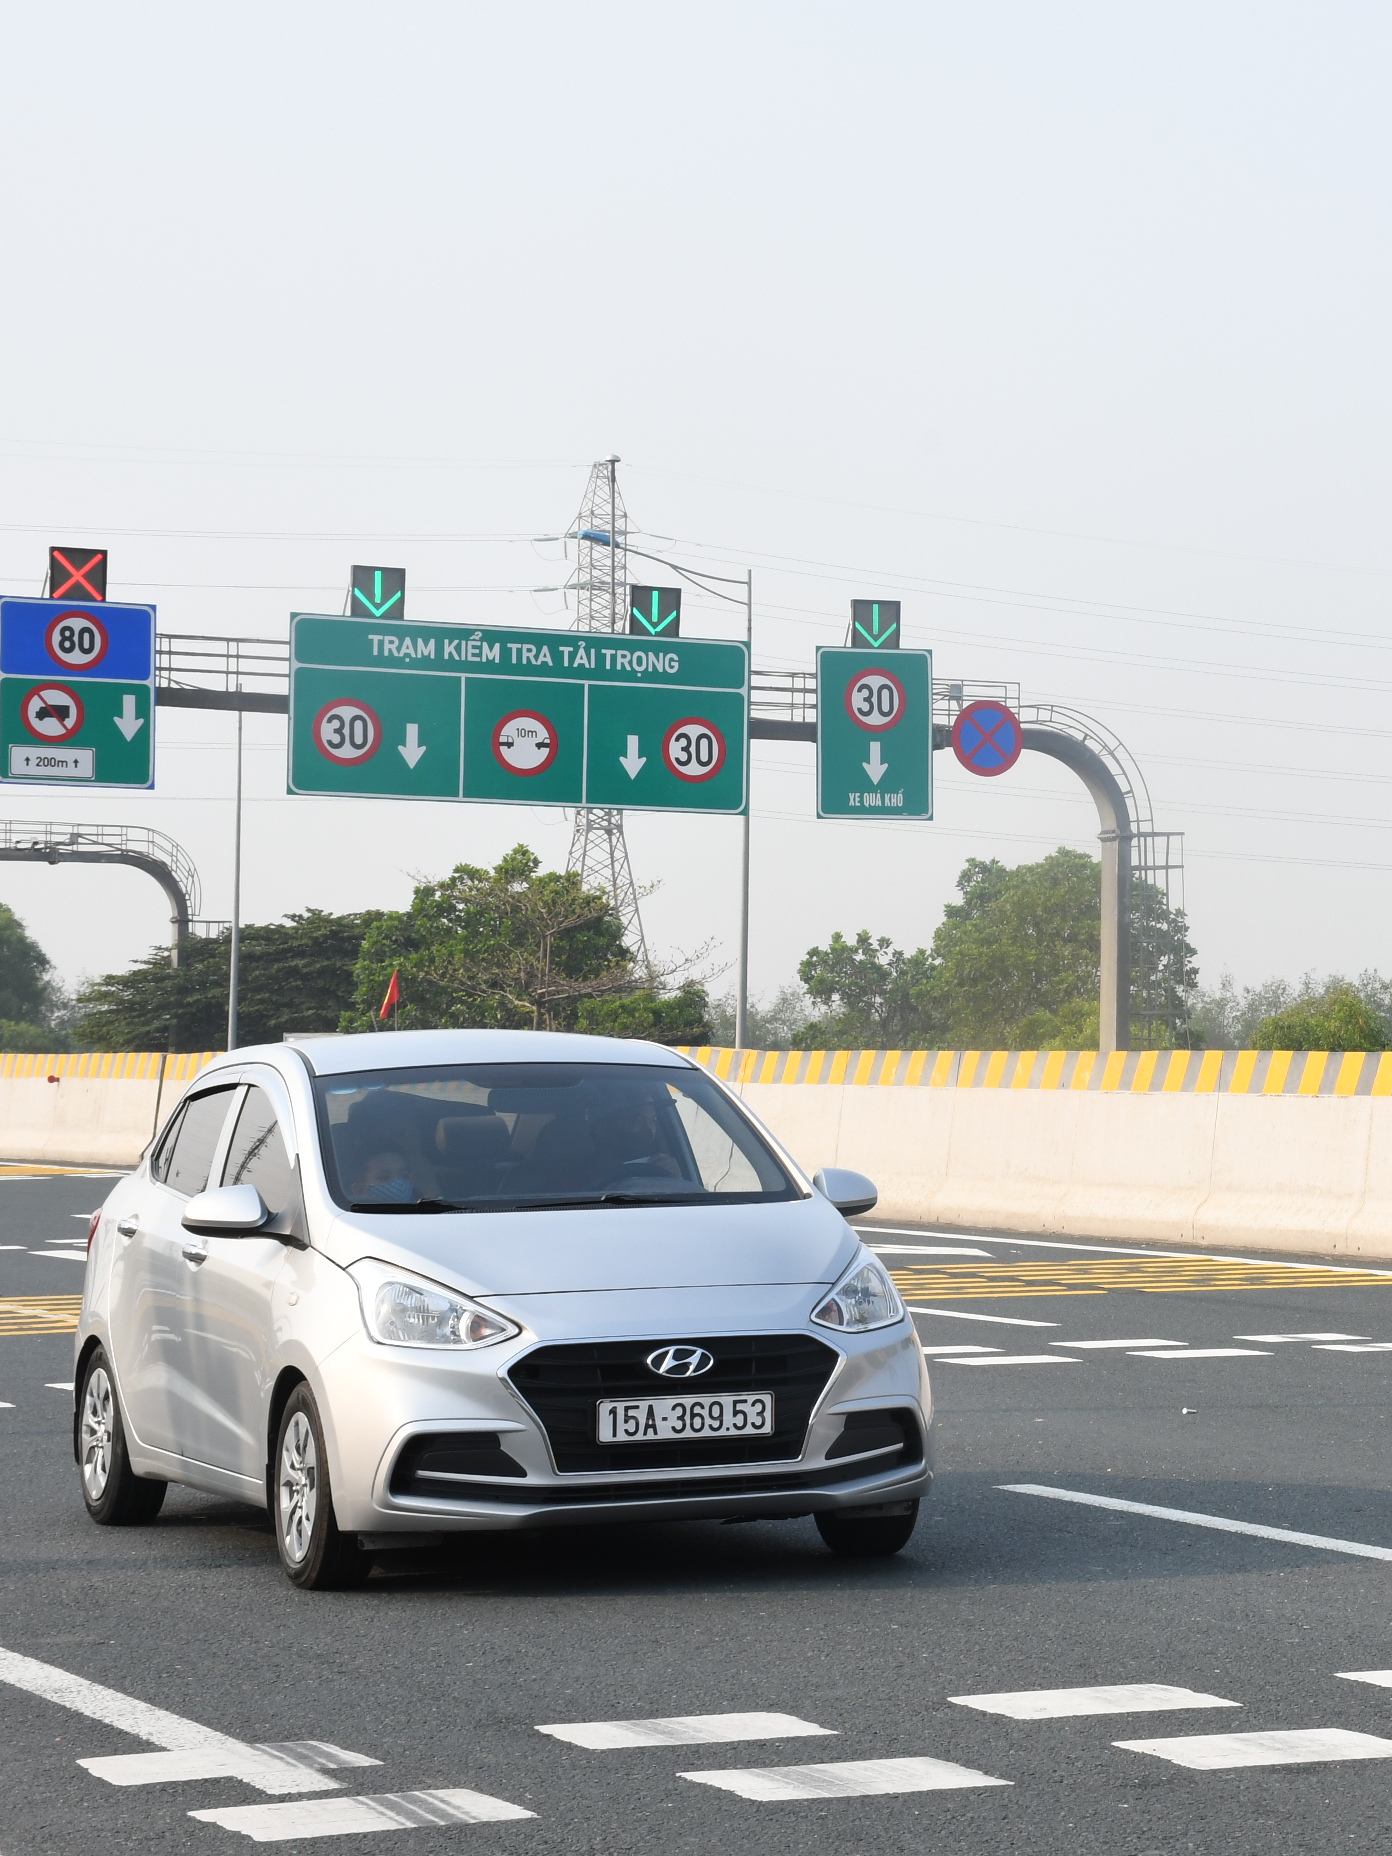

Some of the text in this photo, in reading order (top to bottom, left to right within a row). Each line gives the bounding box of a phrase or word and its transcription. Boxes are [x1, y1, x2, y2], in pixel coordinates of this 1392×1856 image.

[58, 625, 95, 655] 80
[368, 631, 679, 677] TRẠM KIỂM TRA TẢI TRỌNG
[857, 683, 895, 718] 30
[325, 714, 369, 751] 30
[515, 727, 538, 740] 10m
[674, 732, 714, 768] 30
[35, 755, 68, 768] 200m
[848, 792, 861, 806] XE
[863, 790, 882, 808] QUÁ
[608, 1398, 767, 1438] 15A-369.53
